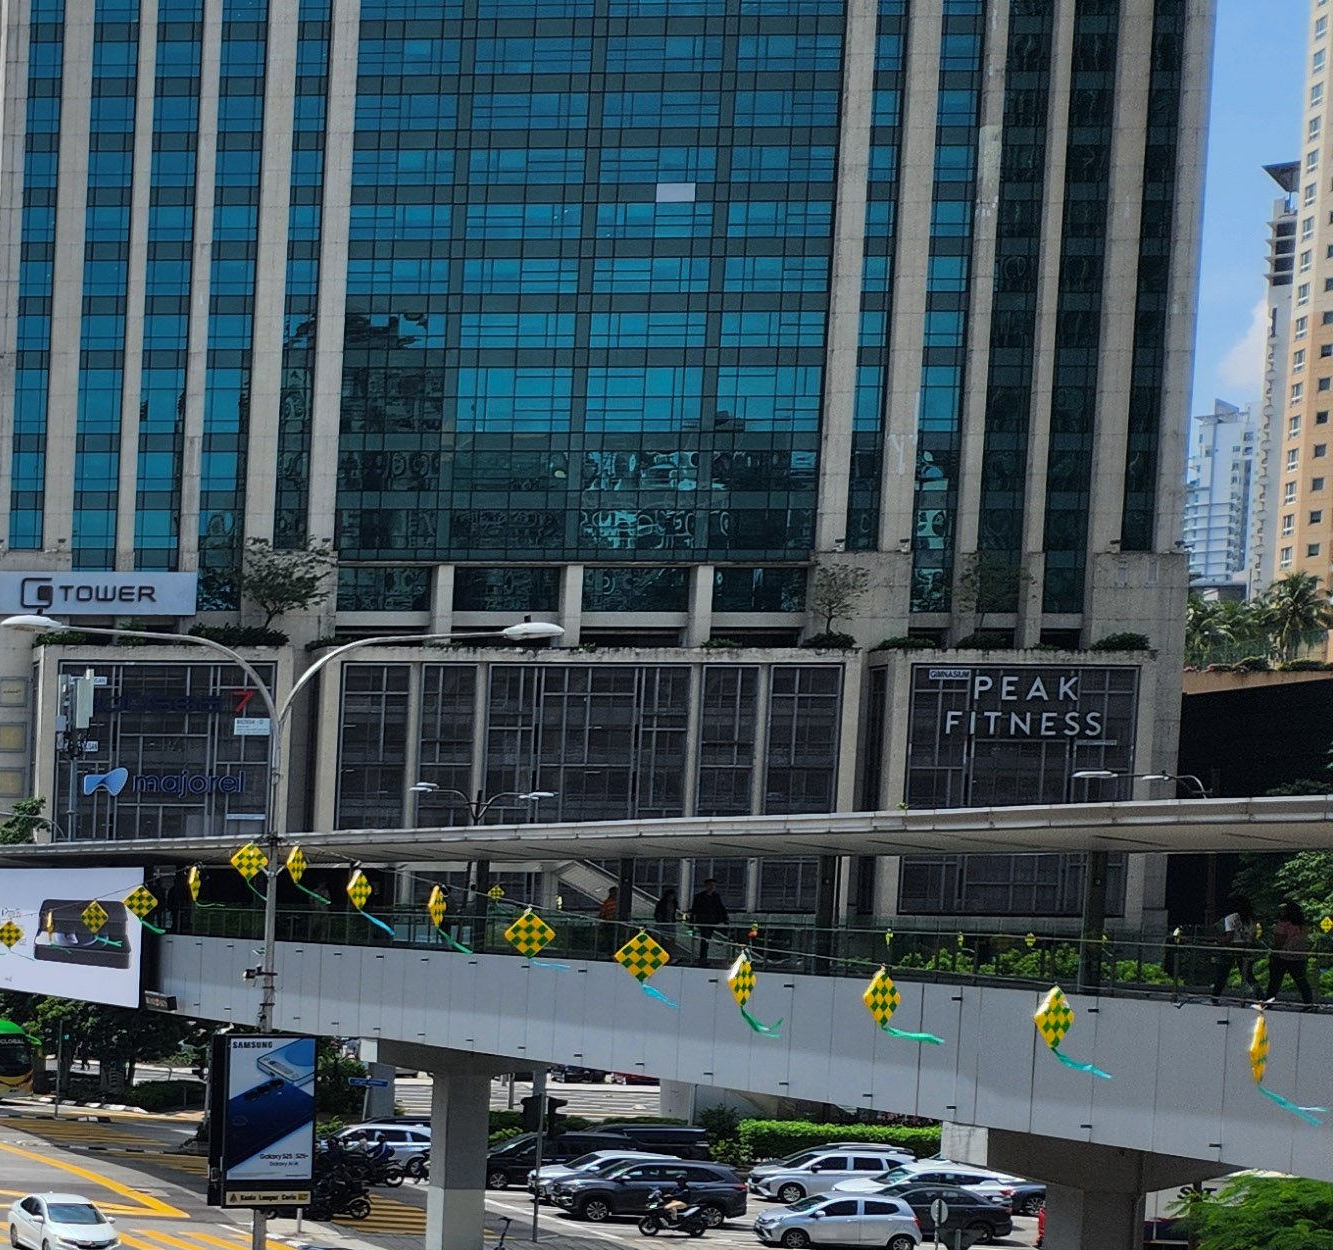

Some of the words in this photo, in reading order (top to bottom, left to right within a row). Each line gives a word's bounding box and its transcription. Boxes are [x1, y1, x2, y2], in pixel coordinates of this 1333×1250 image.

[58, 585, 157, 602] TOWER
[974, 676, 1079, 700] PEAK
[945, 711, 1102, 736] FITNESS
[133, 769, 246, 799] majorel
[233, 1041, 273, 1049] SAMSUNG
